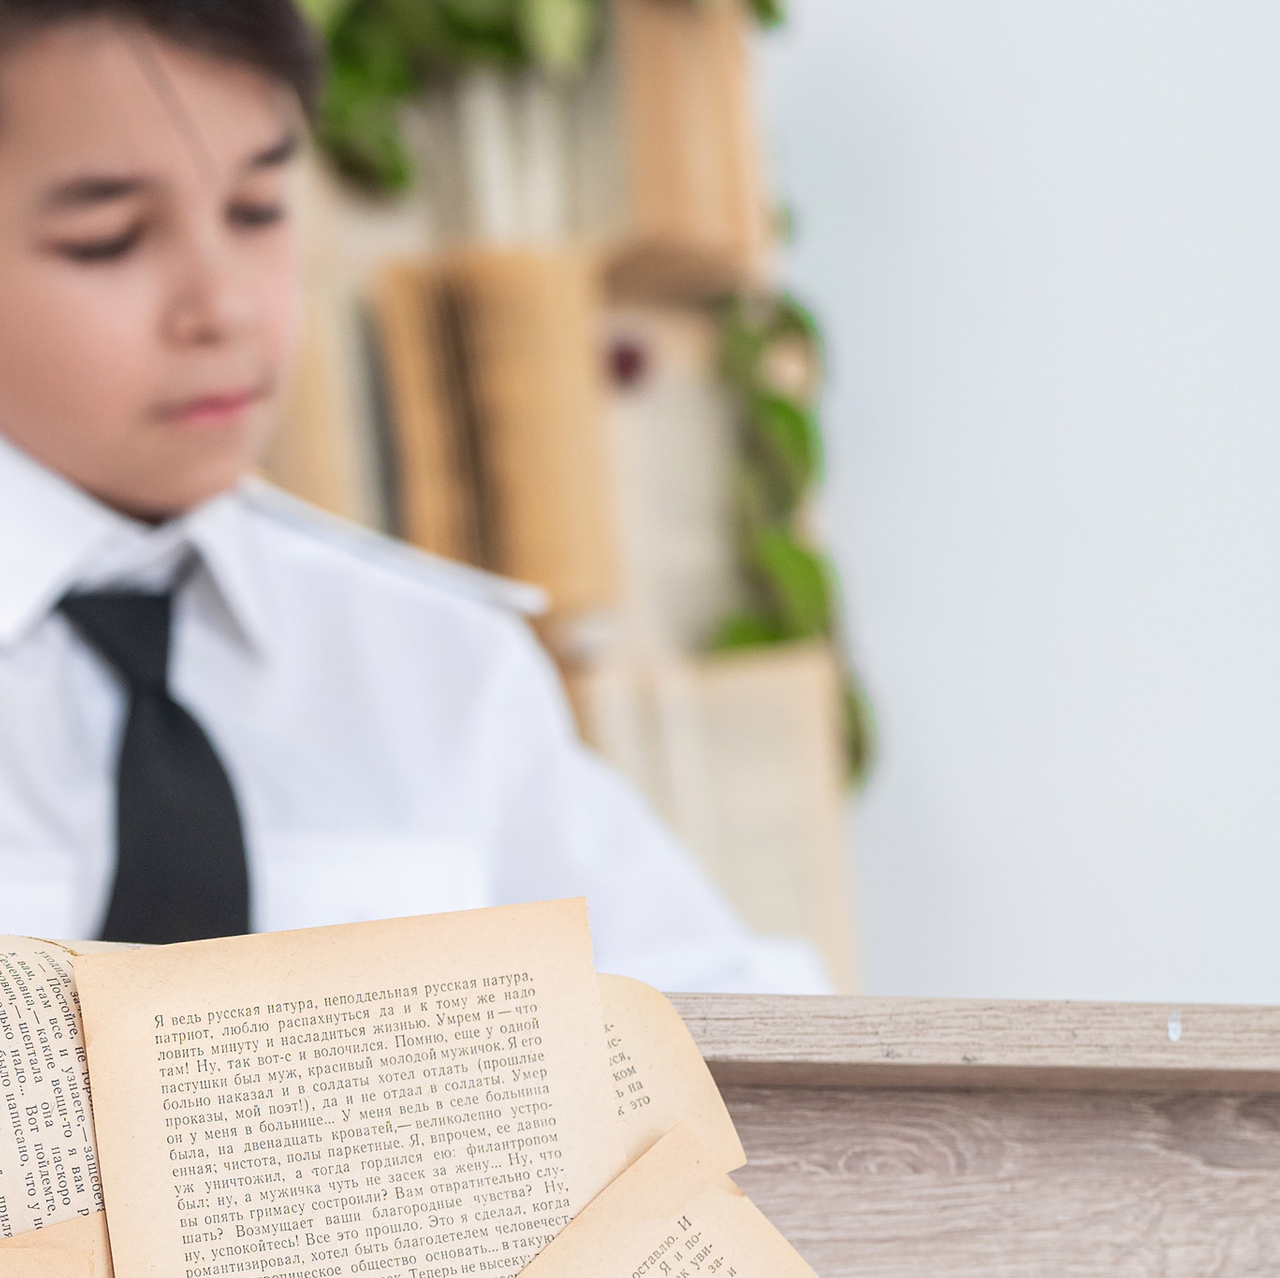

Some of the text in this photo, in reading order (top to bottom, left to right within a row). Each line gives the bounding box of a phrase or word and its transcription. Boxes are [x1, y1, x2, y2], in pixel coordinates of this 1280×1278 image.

[154, 972, 533, 1028] Я ведь русская натура, неподдельная русская натура,
[154, 988, 535, 1045] патриот, люблю распахнуться да и к тому же надо
